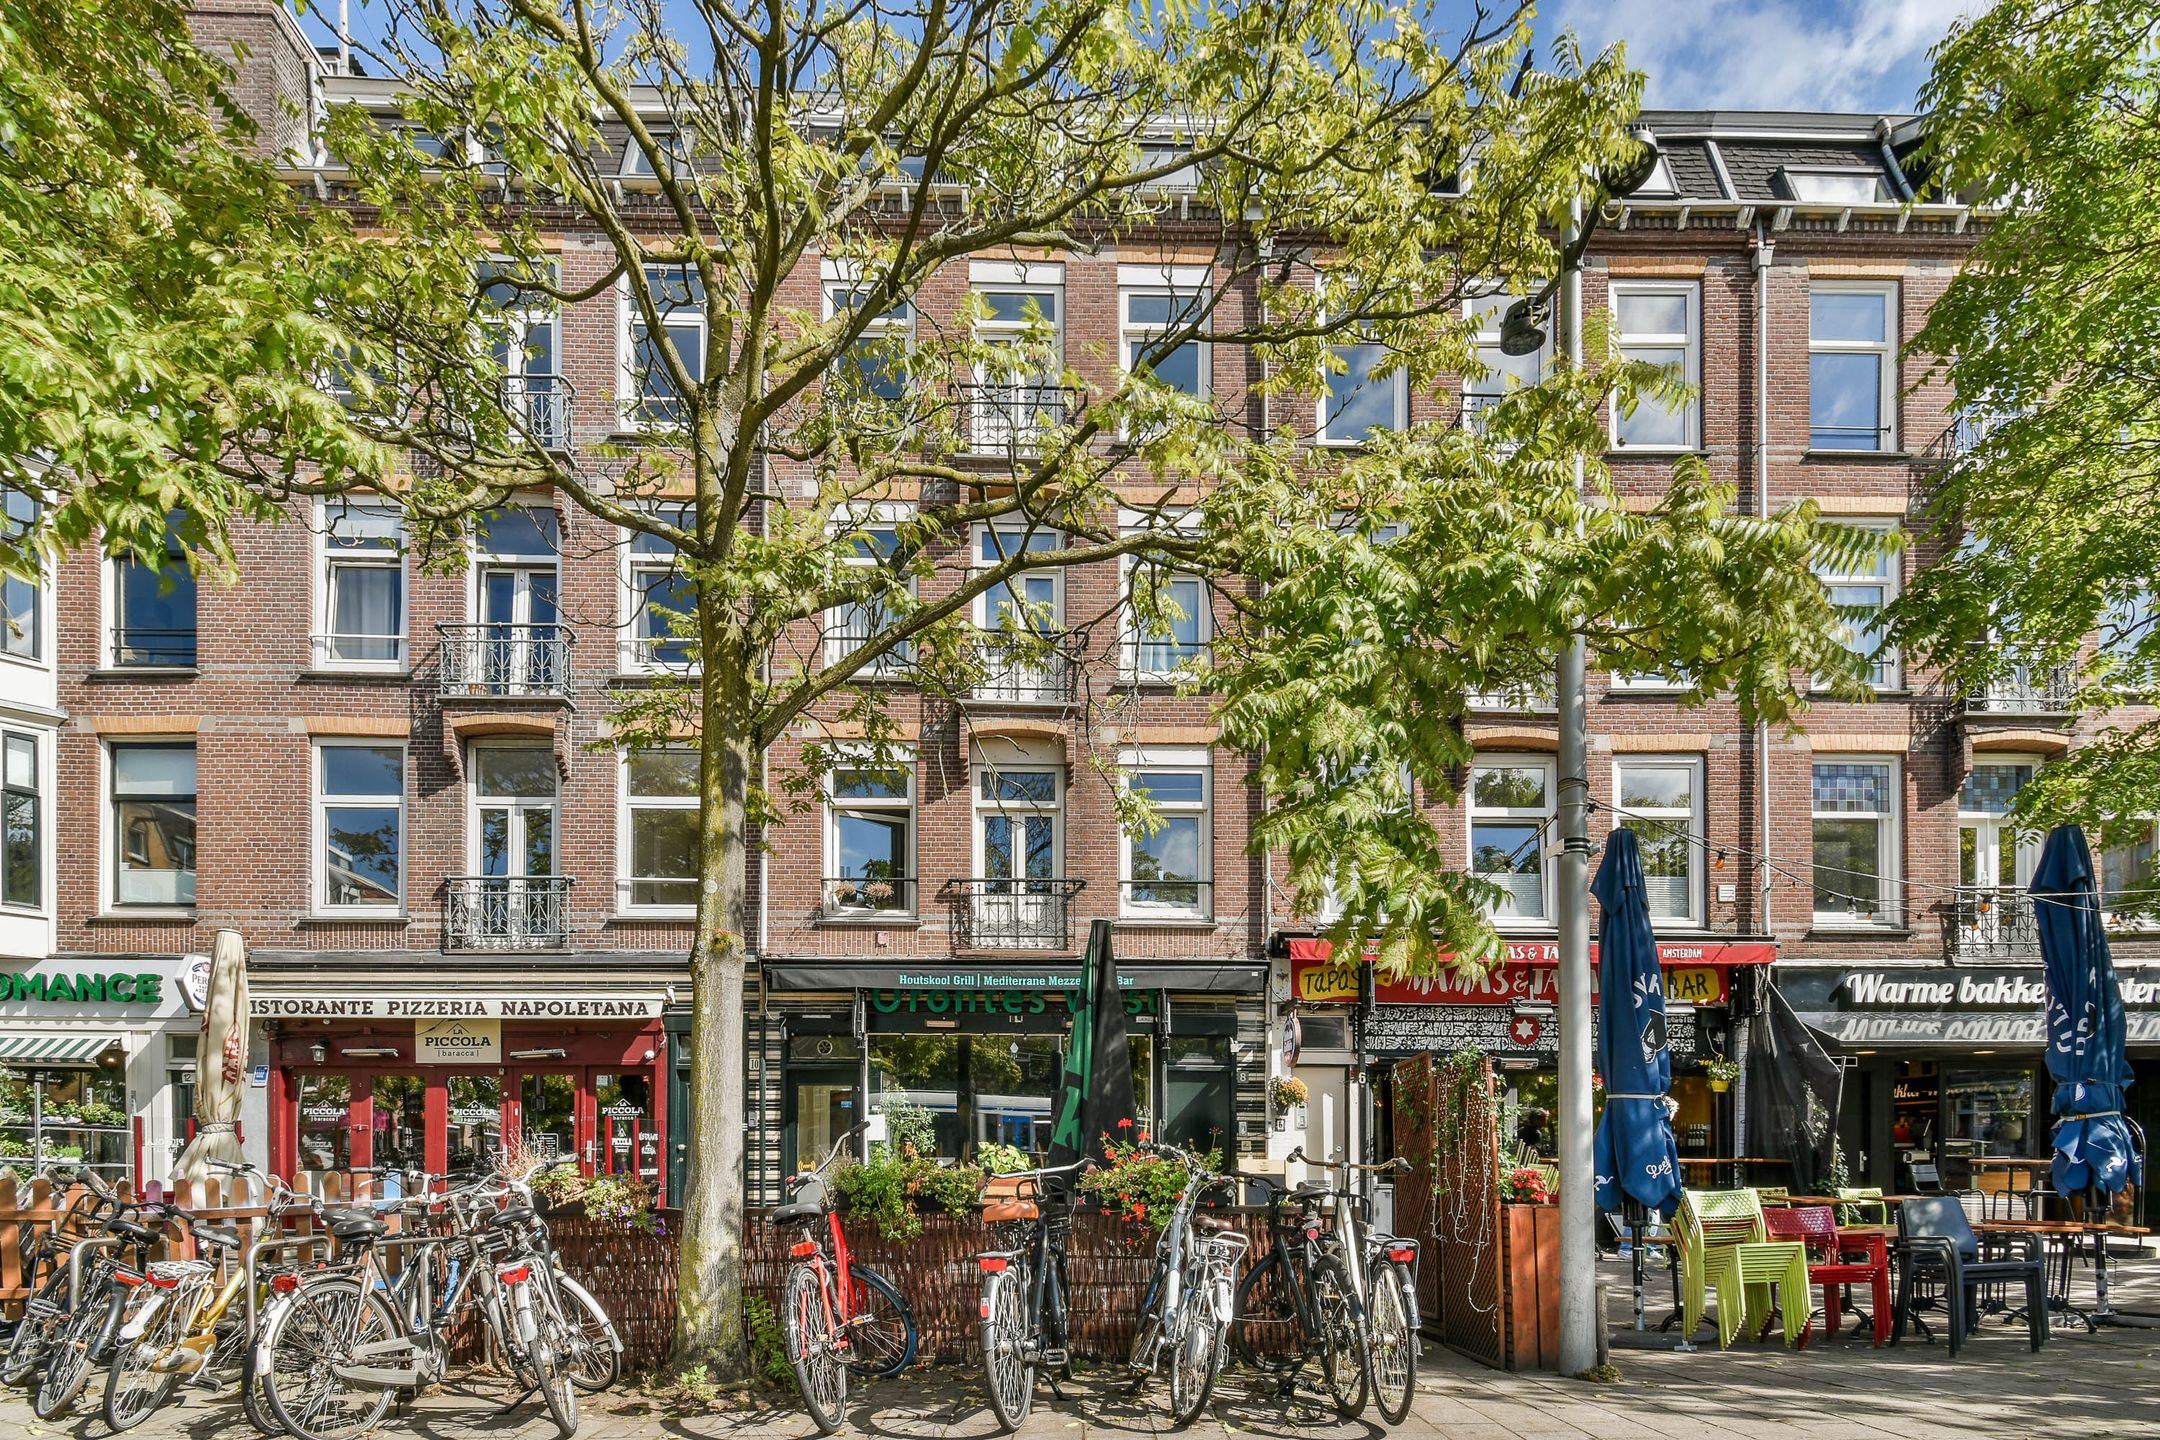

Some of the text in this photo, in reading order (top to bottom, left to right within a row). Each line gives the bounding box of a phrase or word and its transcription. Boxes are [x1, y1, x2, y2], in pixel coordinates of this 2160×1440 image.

[1662, 948, 1703, 958] AMSTERDAM
[899, 974, 1134, 986] Houtskool Grill Mediterrane Mezze Bar
[1513, 970, 1529, 993] &
[1667, 973, 1710, 999] BAR
[1846, 973, 1955, 1003] Warme
[1956, 975, 2046, 1003] bakke
[871, 988, 1046, 1014] Orontes
[250, 1000, 649, 1016] ISTORANTE PIZZERIA NAPOLETANA
[425, 1036, 492, 1047] PICCOLA
[751, 1059, 759, 1069] 10
[183, 1073, 192, 1082] 12
[1240, 1072, 1247, 1082] 8
[1359, 1071, 1366, 1084] 6
[303, 1107, 347, 1116] PICCOLA
[453, 1108, 498, 1116] PICCOLA
[602, 1106, 645, 1115] PICCOLA
